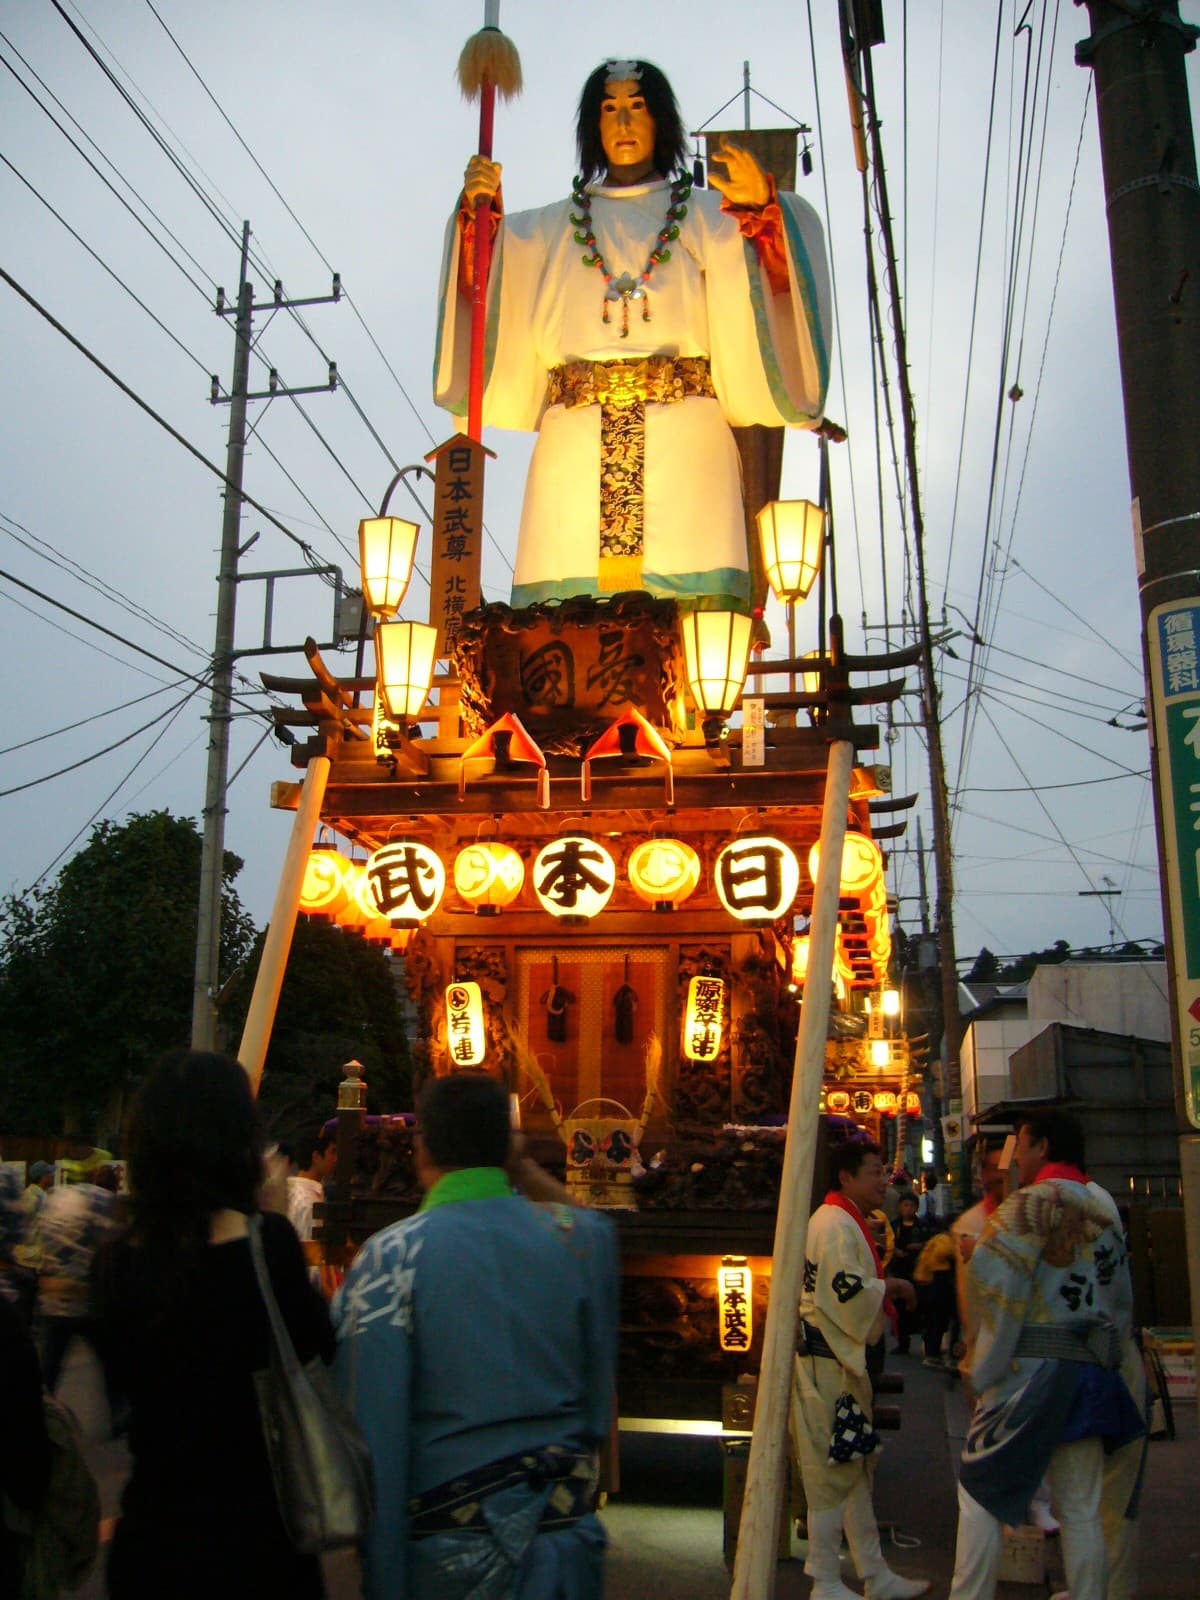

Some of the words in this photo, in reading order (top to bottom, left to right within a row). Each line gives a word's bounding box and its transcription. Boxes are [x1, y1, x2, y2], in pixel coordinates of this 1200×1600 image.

[440, 447, 473, 563] 日本武尊
[1164, 610, 1199, 692] 循環器科
[367, 846, 435, 916] 武
[535, 840, 610, 908] 本
[719, 845, 784, 913] 日
[723, 1271, 749, 1349] 日本武会
